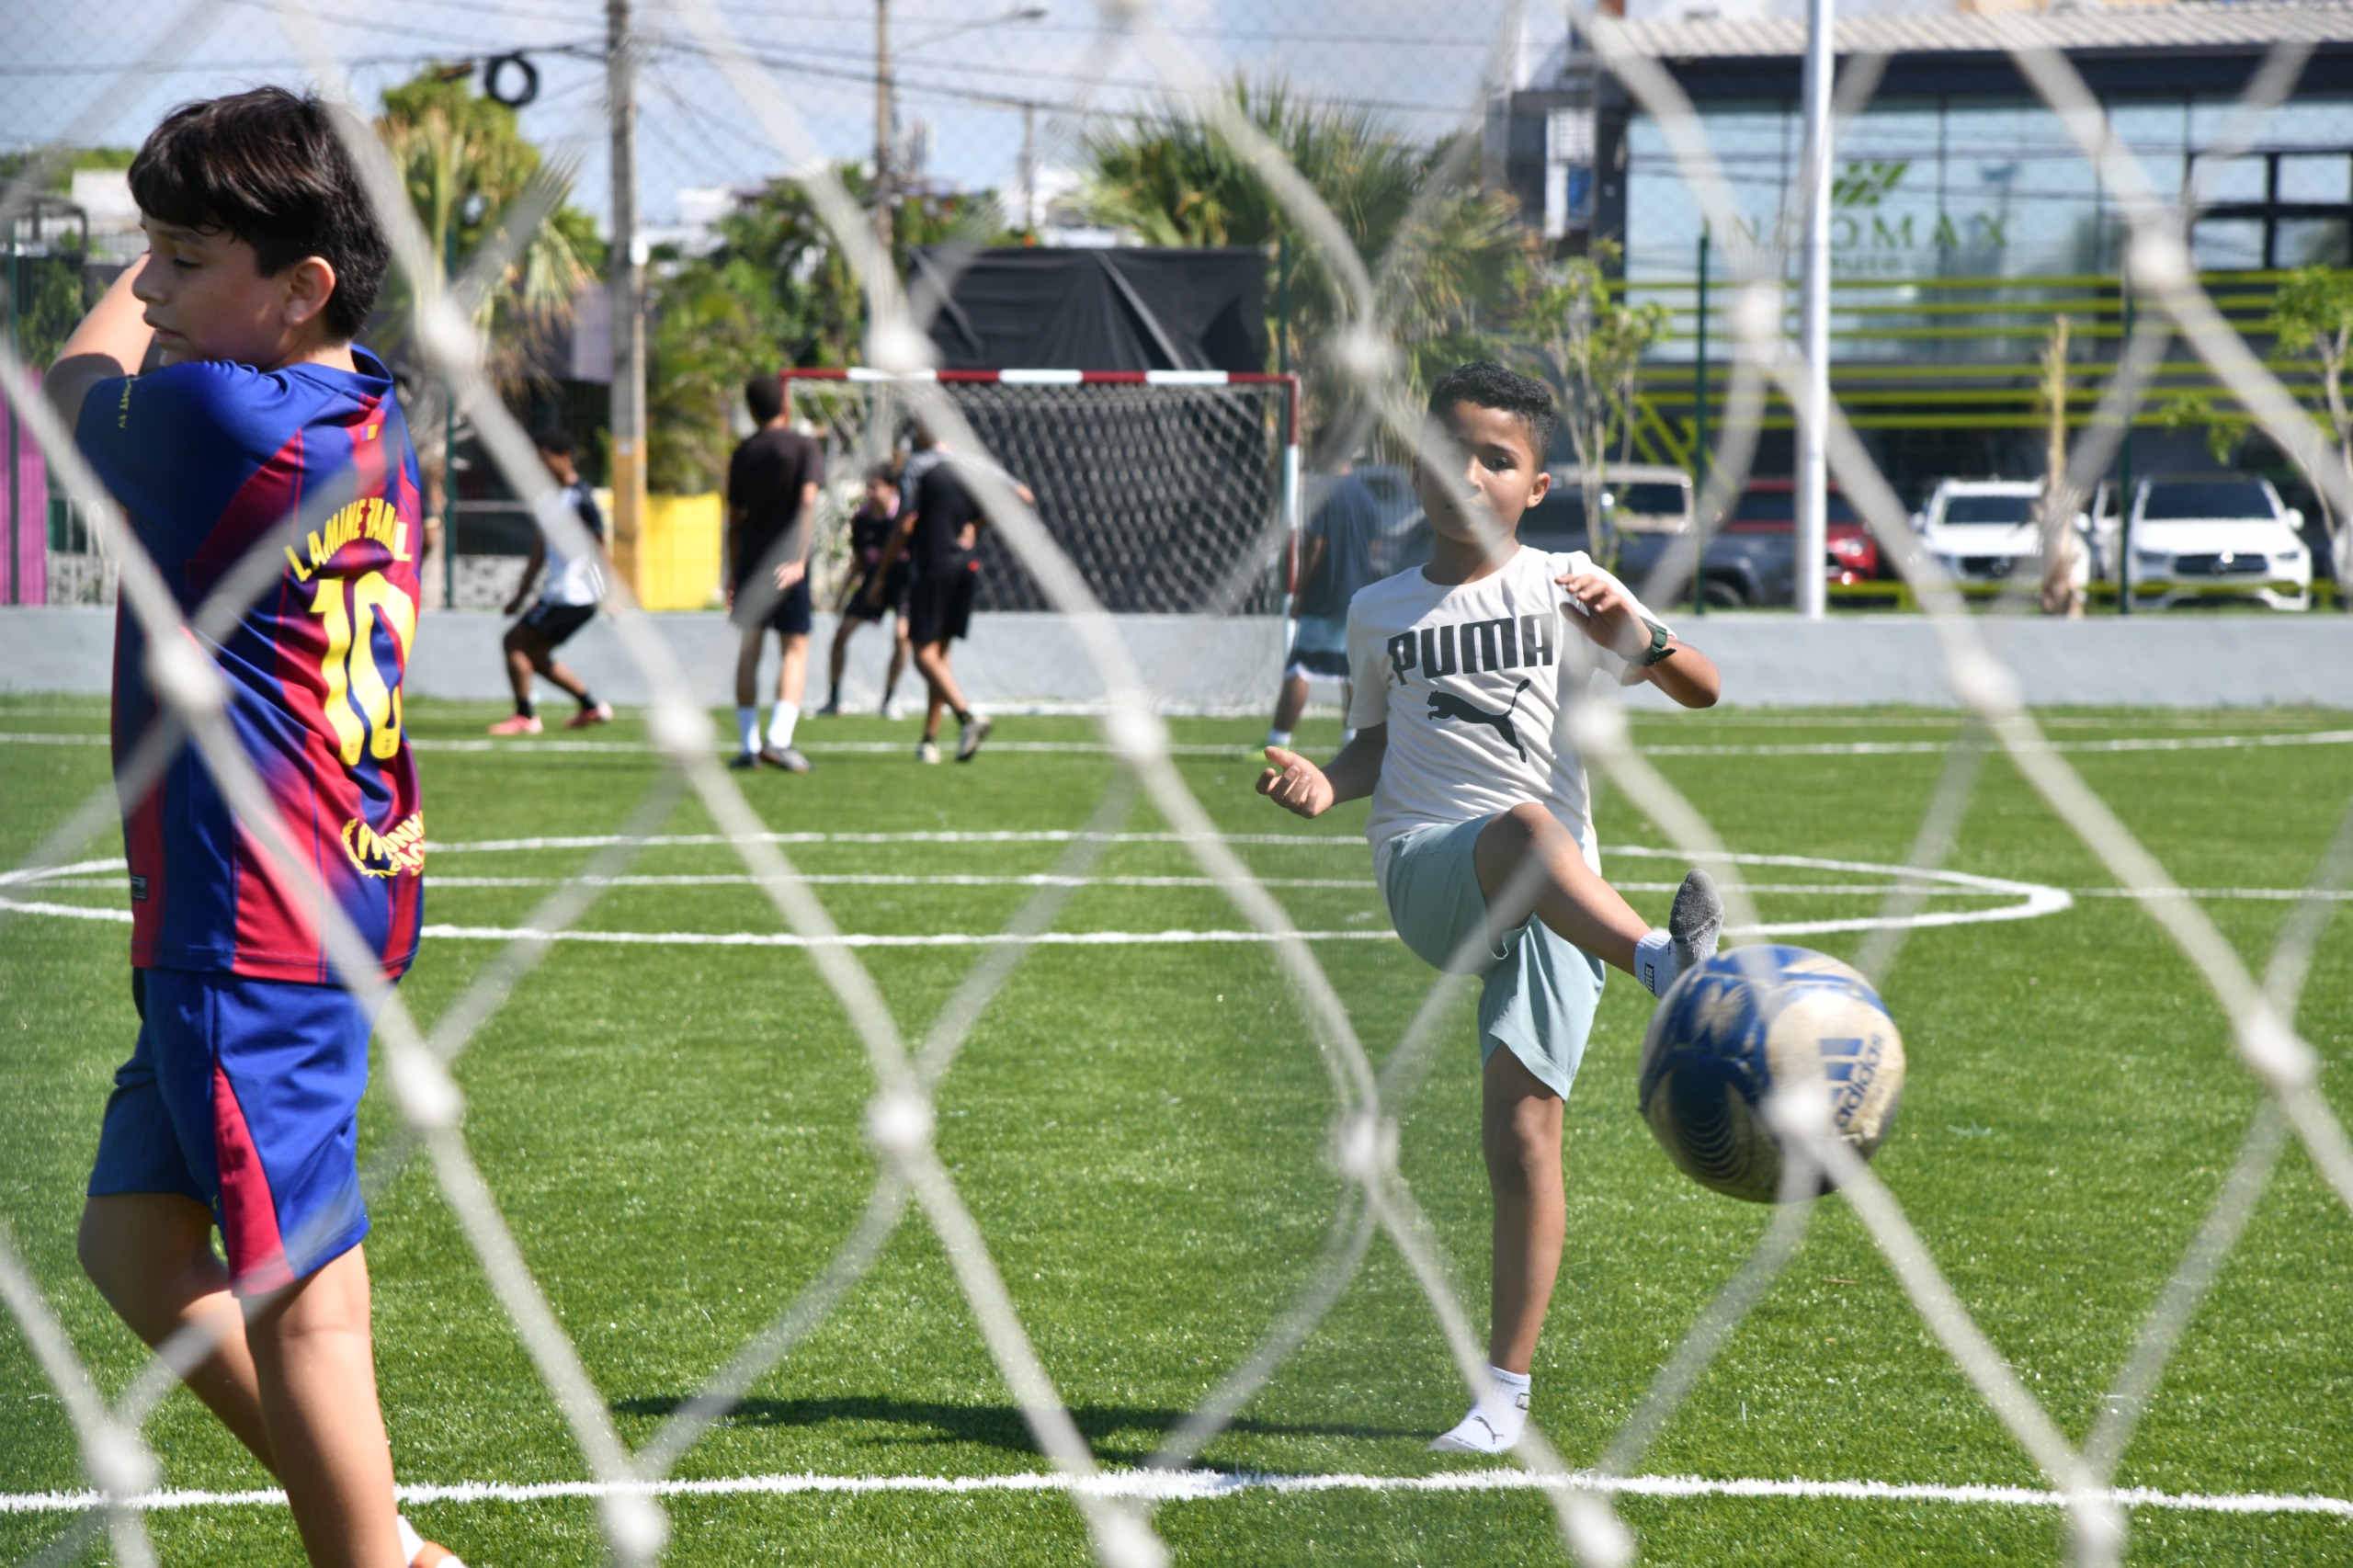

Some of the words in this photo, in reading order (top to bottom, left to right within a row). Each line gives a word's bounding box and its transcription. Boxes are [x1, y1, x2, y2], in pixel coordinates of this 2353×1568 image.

[284, 498, 367, 582] LAMINE
[310, 571, 415, 766] 10
[1387, 613, 1553, 686] PUMA
[1833, 1033, 1882, 1128] adidas
